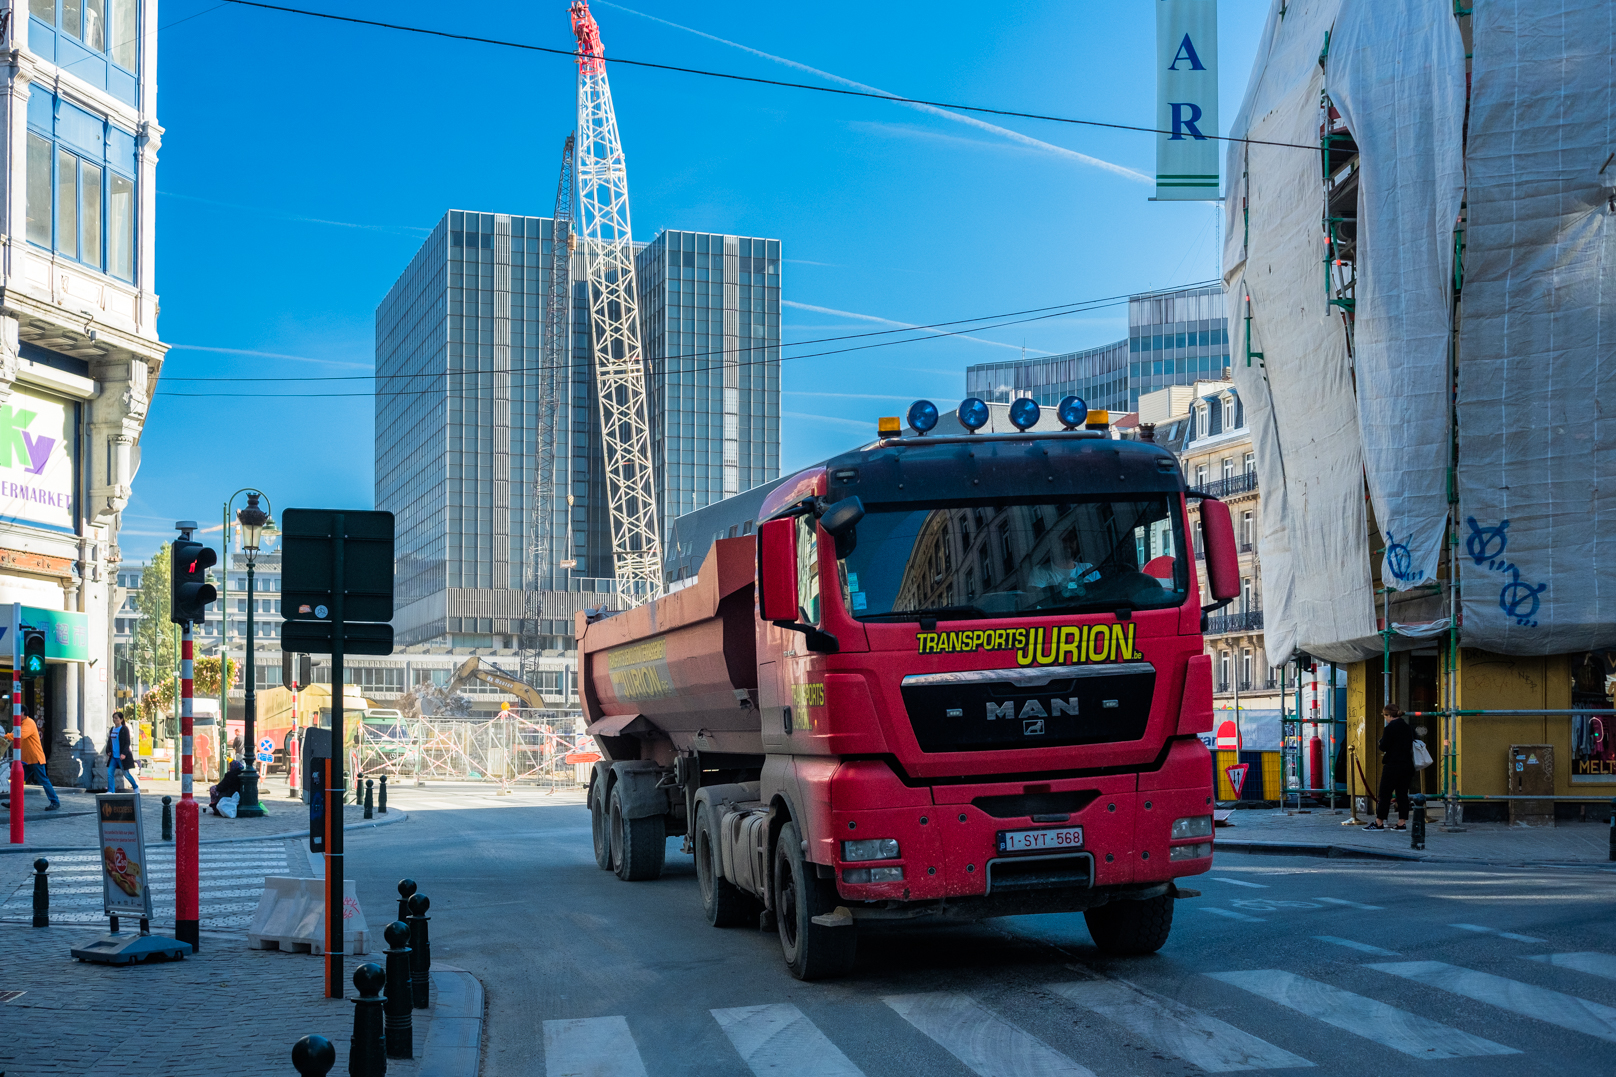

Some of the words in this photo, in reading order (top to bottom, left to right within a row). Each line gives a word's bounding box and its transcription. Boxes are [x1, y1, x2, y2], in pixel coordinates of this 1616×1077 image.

[1, 481, 72, 509] ERMARKET
[917, 628, 1026, 653] TRANSPORTS
[620, 664, 664, 698] JURION
[791, 683, 824, 706] TRANSPORTS
[986, 697, 1079, 720] MAN
[1579, 760, 1616, 773] MELT
[1009, 831, 1080, 848] 1-SYT-568
